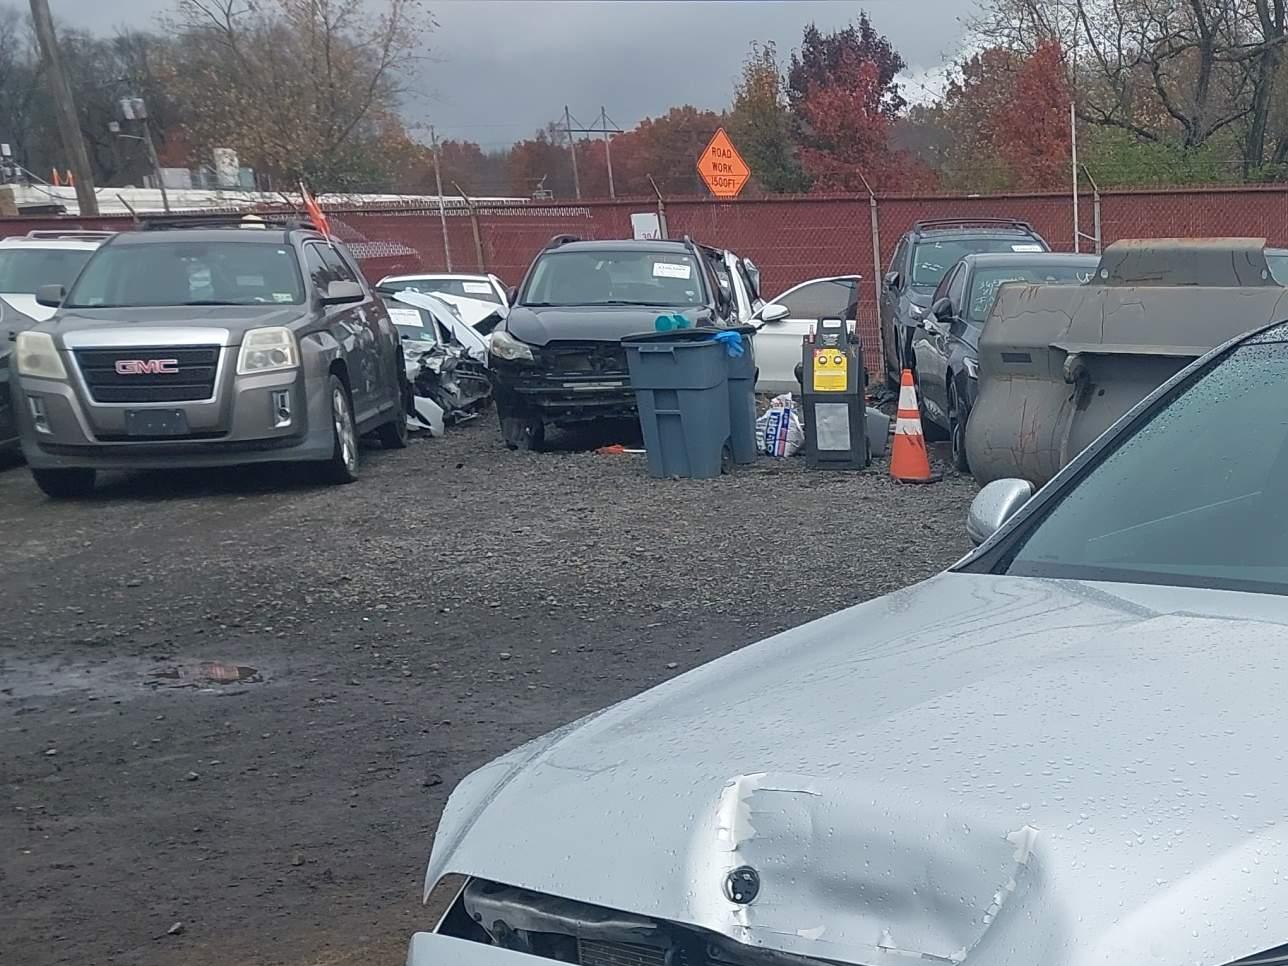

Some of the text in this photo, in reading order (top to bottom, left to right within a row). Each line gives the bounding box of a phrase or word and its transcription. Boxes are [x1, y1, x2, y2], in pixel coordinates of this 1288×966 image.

[711, 147, 732, 159] ROAD
[712, 162, 733, 174] WORK
[115, 359, 179, 374] GMC
